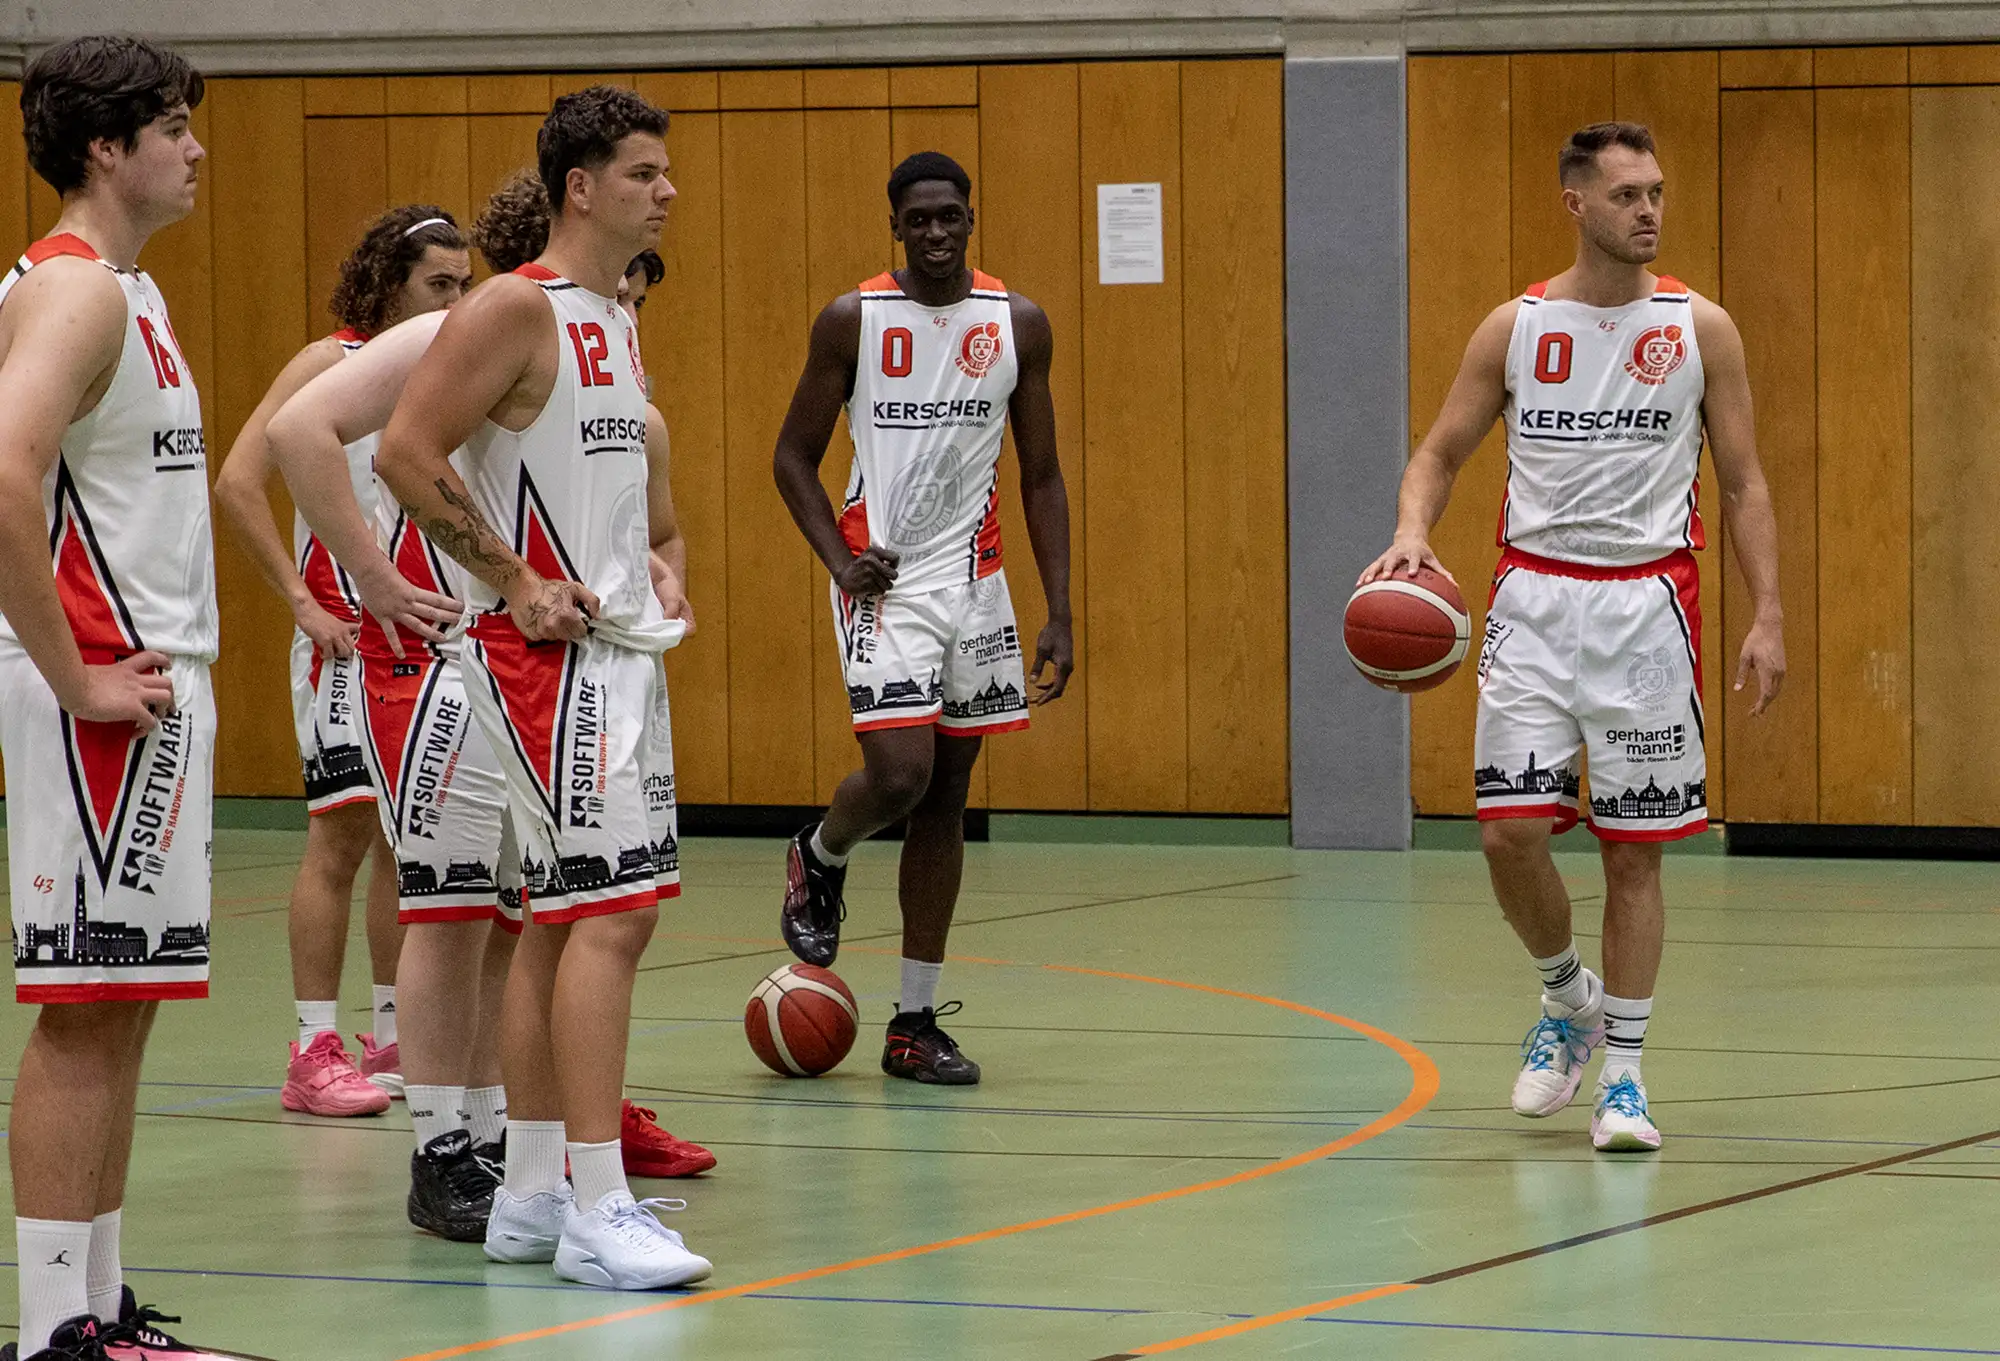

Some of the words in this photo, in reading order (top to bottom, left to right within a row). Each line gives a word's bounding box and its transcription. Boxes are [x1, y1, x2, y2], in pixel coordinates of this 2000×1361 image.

[566, 322, 614, 387] 12
[882, 327, 913, 378] 0
[1534, 332, 1573, 384] 0
[873, 399, 992, 420] KERSCHER
[1520, 408, 1672, 431] KERSCHER
[960, 627, 1003, 654] gerhard
[572, 677, 597, 792] SOFTWARE
[1606, 726, 1671, 744] gerhard
[413, 696, 462, 803] SOFTWARE
[599, 733, 607, 773] HANDWERK
[1627, 743, 1672, 755] mann
[597, 774, 607, 794] FÜRS
[436, 790, 448, 808] FÜRS
[160, 830, 174, 853] FÜRS
[167, 776, 186, 828] HANDWERK
[33, 875, 54, 894] 43
